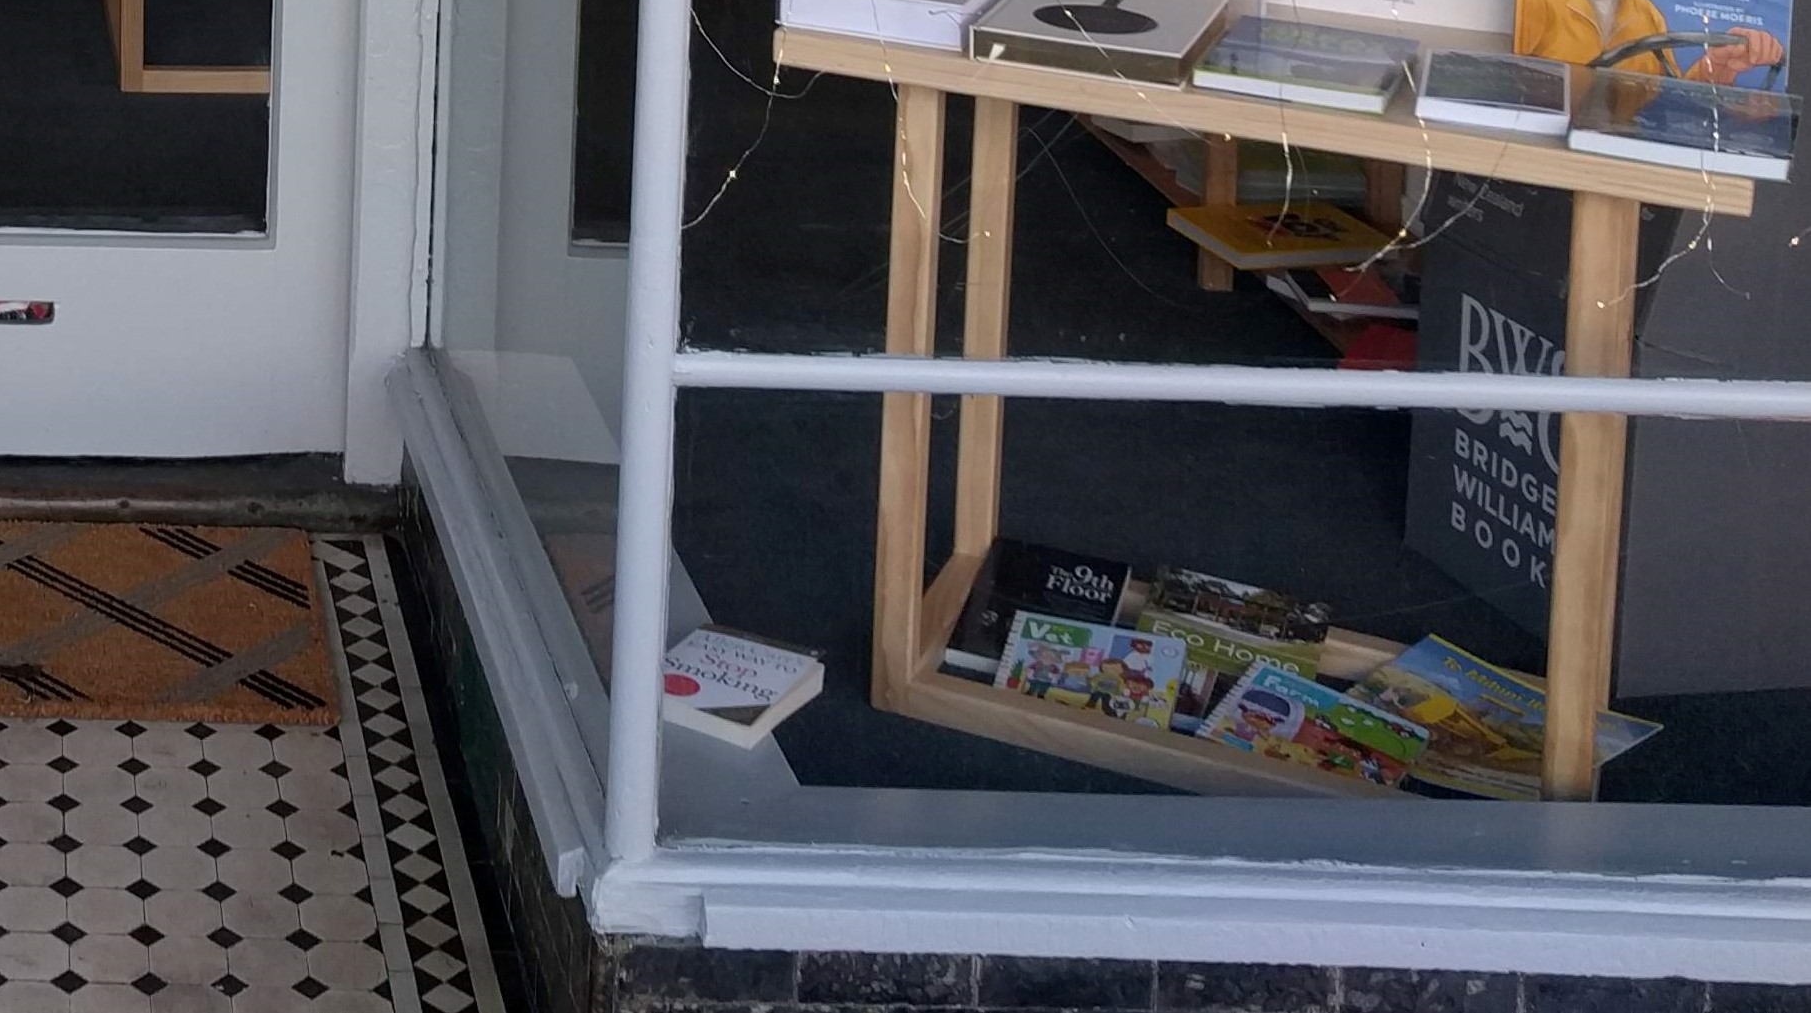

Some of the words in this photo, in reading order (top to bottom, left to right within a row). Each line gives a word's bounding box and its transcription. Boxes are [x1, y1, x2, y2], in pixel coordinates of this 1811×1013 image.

[1453, 427, 1558, 518] BRIDGE
[1452, 463, 1556, 557] WILLIAM
[1449, 501, 1549, 589] BOOK
[1045, 572, 1113, 605] Floor
[1073, 564, 1116, 592] 9th
[1027, 620, 1074, 645] Vet
[1151, 619, 1205, 647] Eco
[664, 656, 779, 703] Smoking
[699, 653, 758, 679] Stop
[1263, 674, 1321, 710] Farm
